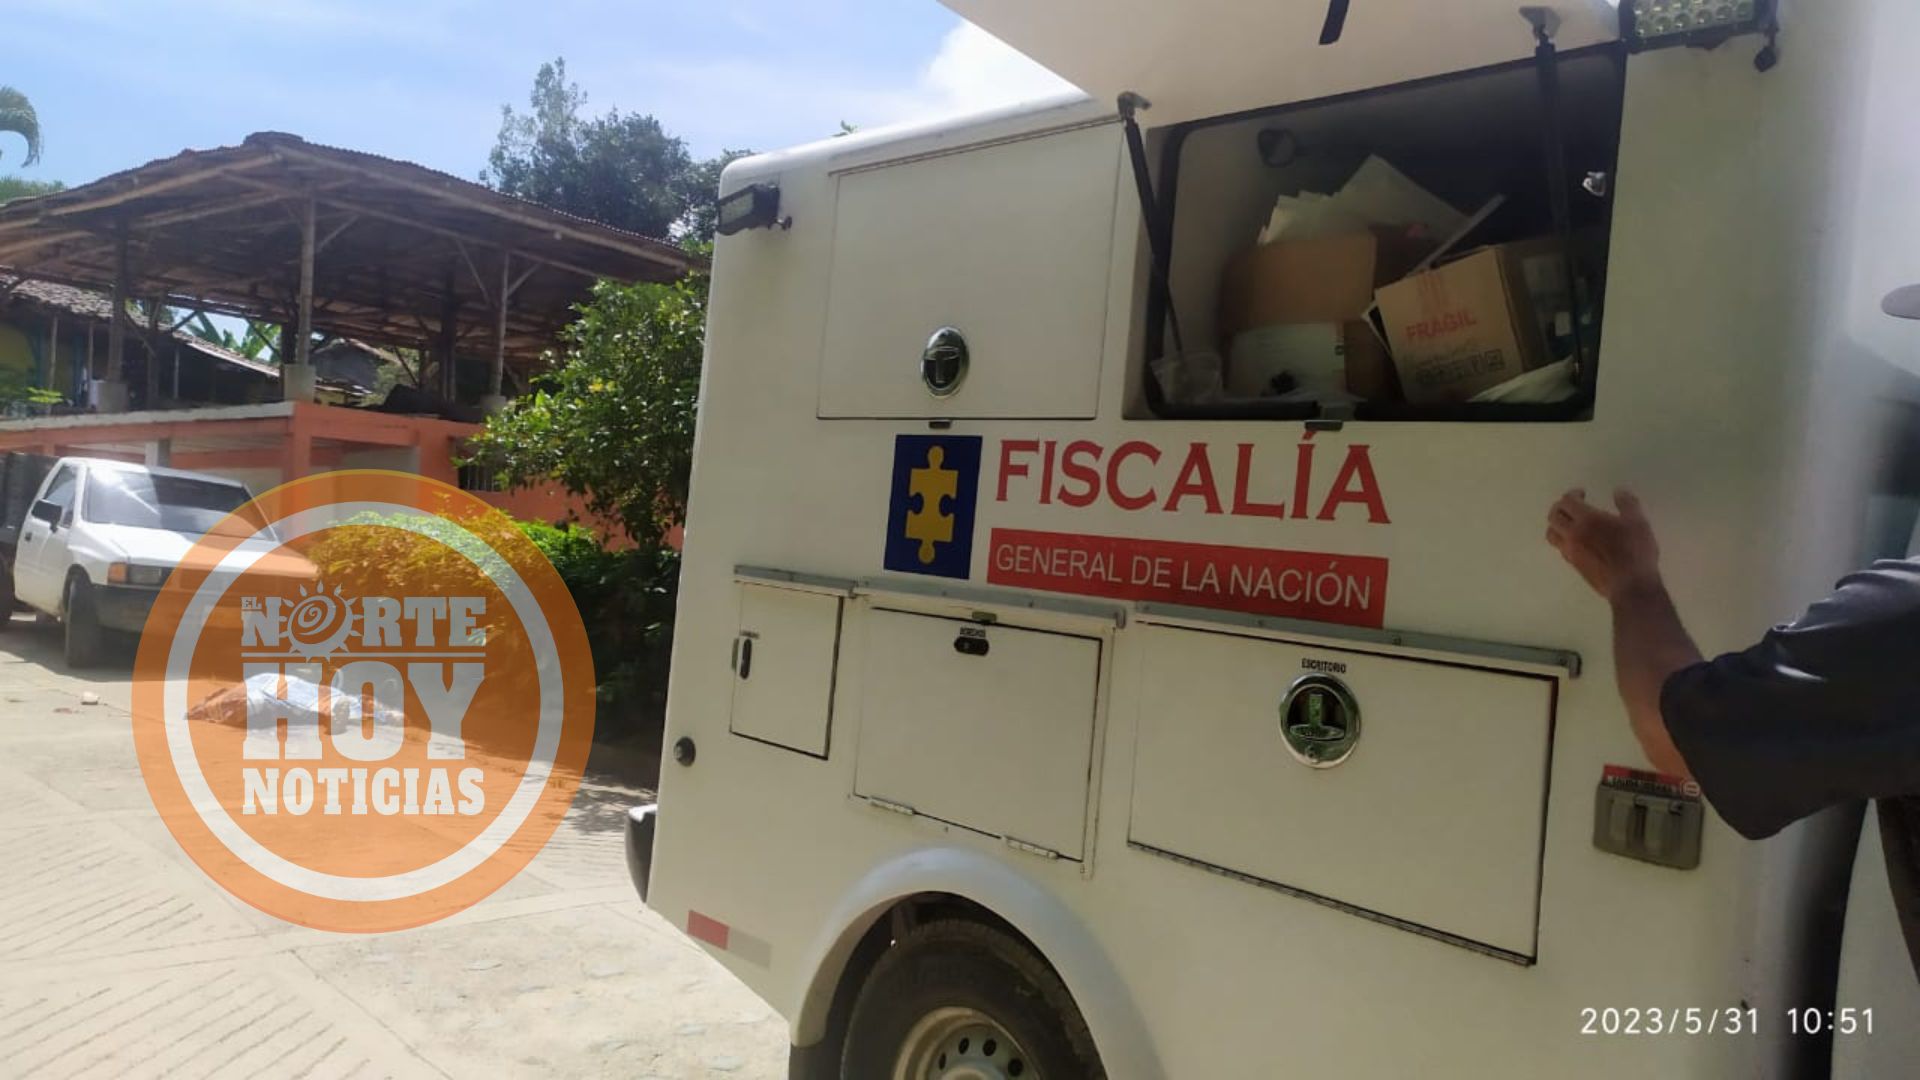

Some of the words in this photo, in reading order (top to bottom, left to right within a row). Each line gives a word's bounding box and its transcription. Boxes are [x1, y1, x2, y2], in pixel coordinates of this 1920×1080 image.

[1404, 310, 1477, 341] FRAGIL
[996, 431, 1391, 524] FISCALÍA
[996, 544, 1123, 584] GENERAL
[1131, 555, 1171, 588] DE
[1181, 560, 1220, 593] LA
[1230, 561, 1371, 610] NACIÓN
[1301, 658, 1347, 674] ESCRITORIO
